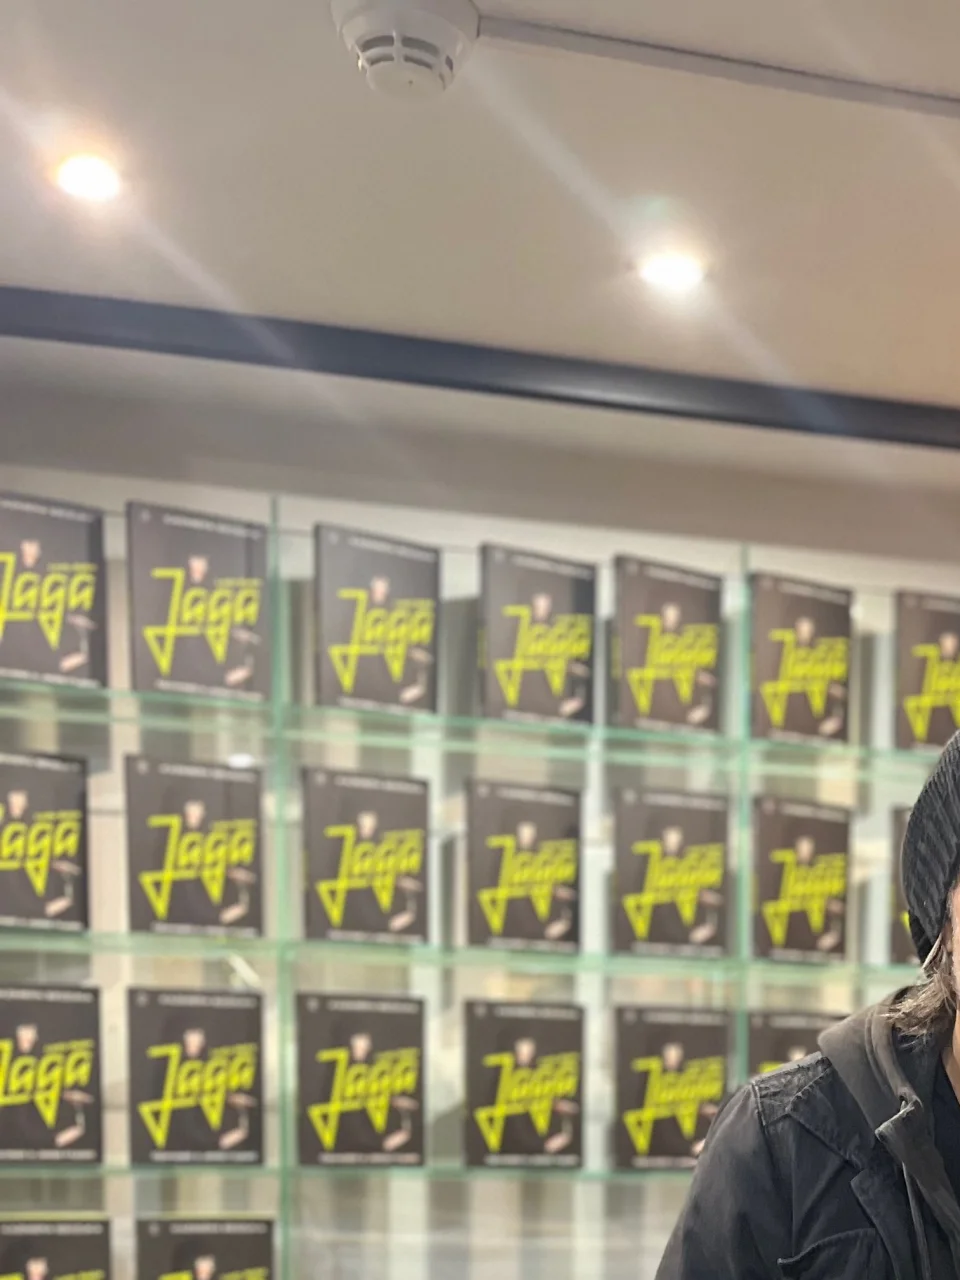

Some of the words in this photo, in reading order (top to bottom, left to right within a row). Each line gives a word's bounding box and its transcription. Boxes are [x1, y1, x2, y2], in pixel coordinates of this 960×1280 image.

[143, 568, 258, 675] Jaga
[138, 815, 256, 921] Jaga
[316, 827, 424, 926] Jaga
[138, 1043, 257, 1149] Jaga
[307, 1047, 420, 1151] Jaga
